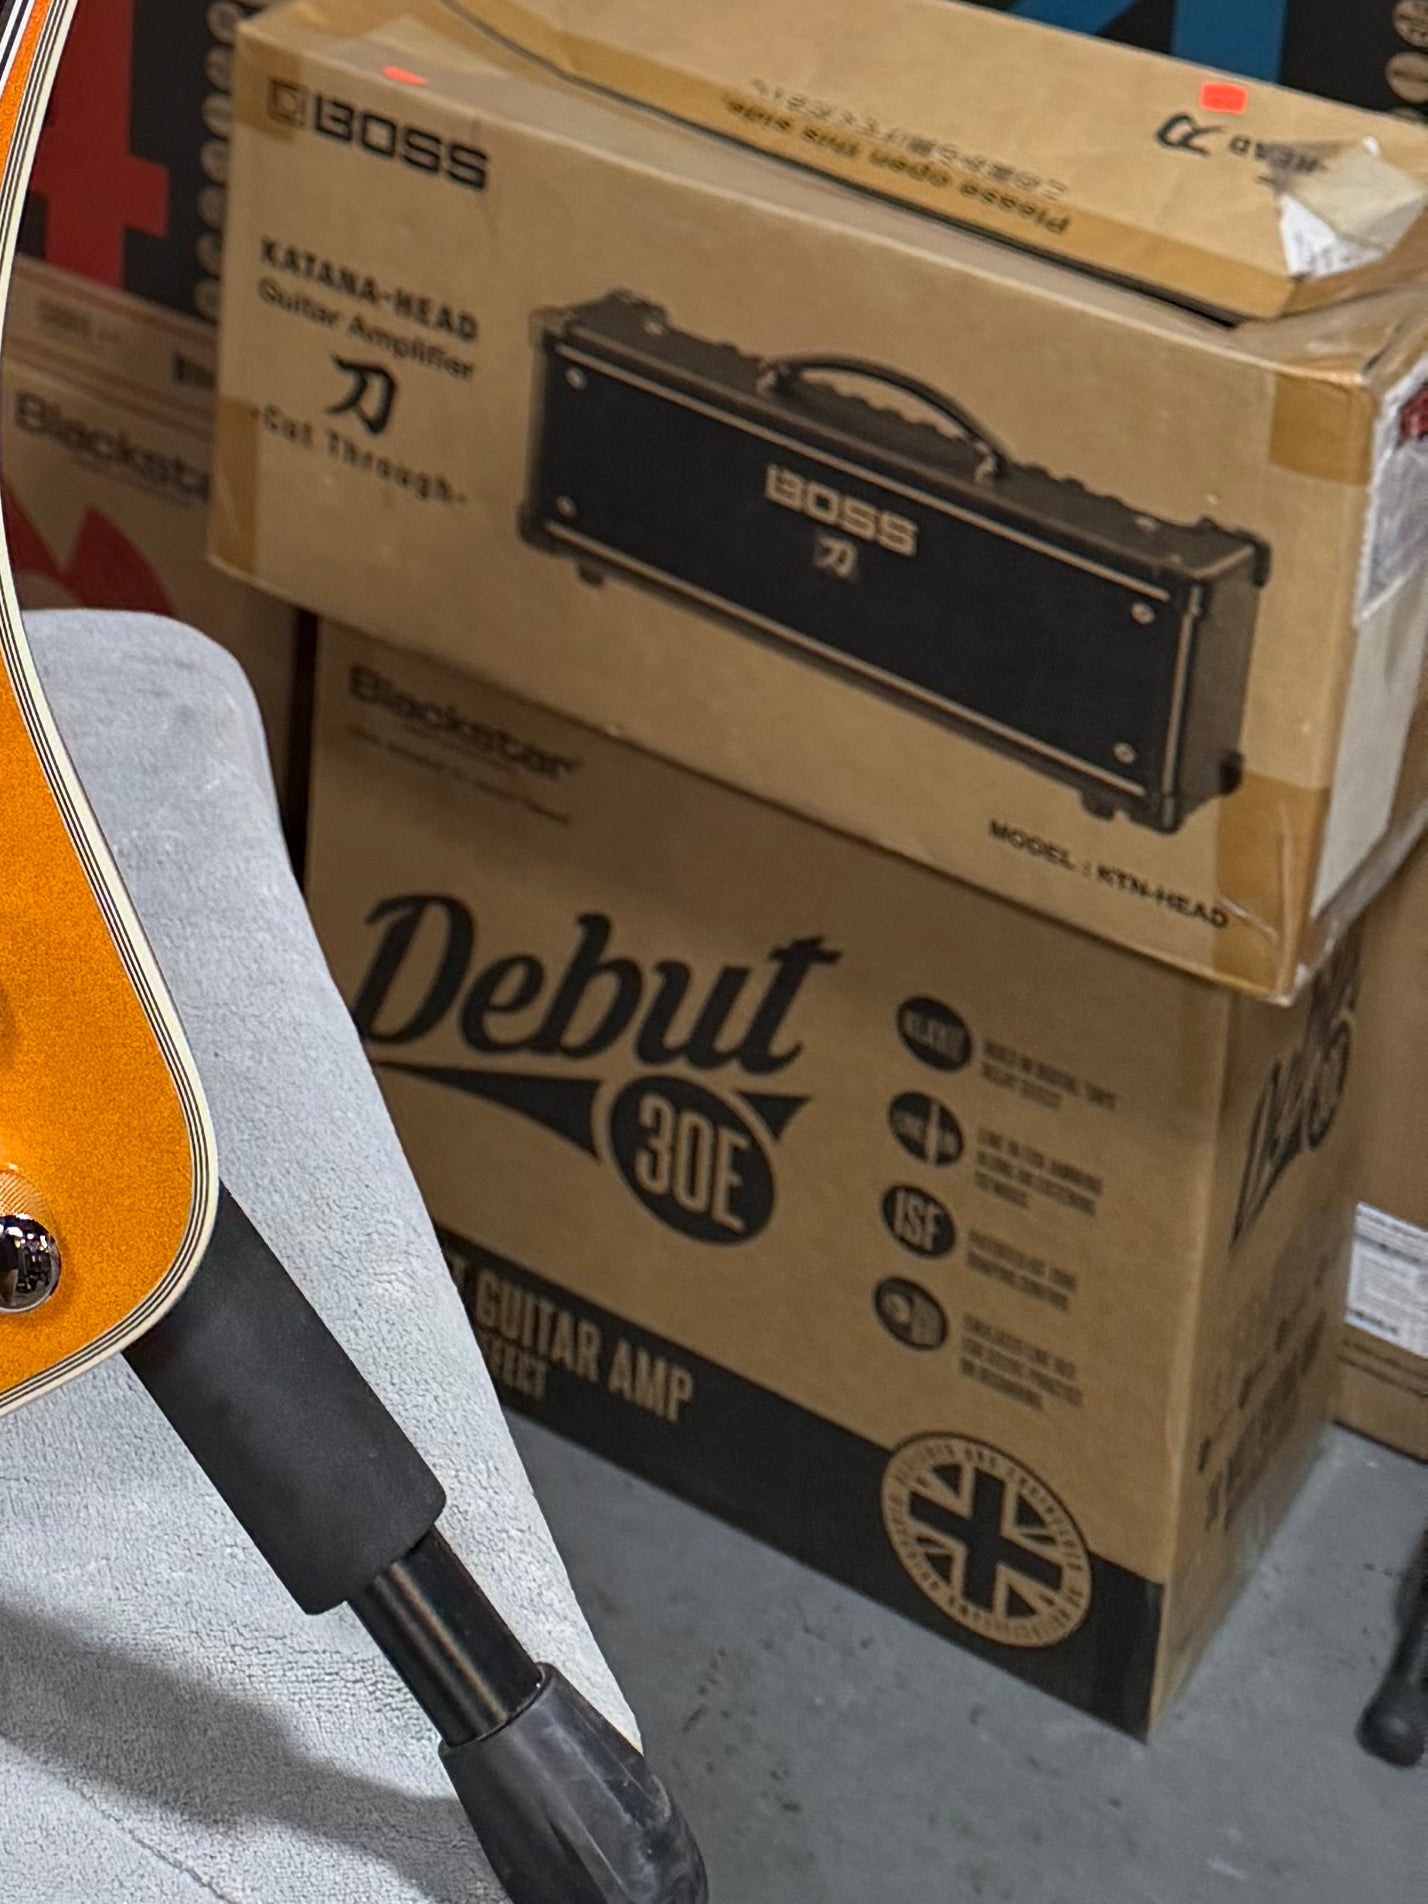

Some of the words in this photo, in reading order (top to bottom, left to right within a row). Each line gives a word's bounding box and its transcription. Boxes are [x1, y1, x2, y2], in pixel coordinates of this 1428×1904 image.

[312, 94, 491, 192] BOSS
[800, 124, 860, 159] this
[867, 147, 953, 188] open
[958, 180, 1072, 236] Please
[257, 275, 342, 329] Guitar
[348, 314, 476, 381] Amplifier
[259, 235, 480, 343] KATANA-HEAD
[764, 462, 919, 557] BOSS
[348, 665, 582, 780] Blackstar
[988, 818, 1076, 872] MODEL
[355, 893, 843, 1075] Debut
[635, 1094, 750, 1235] 30E
[475, 1269, 602, 1384] GUITAR
[607, 1336, 694, 1424] AMP
